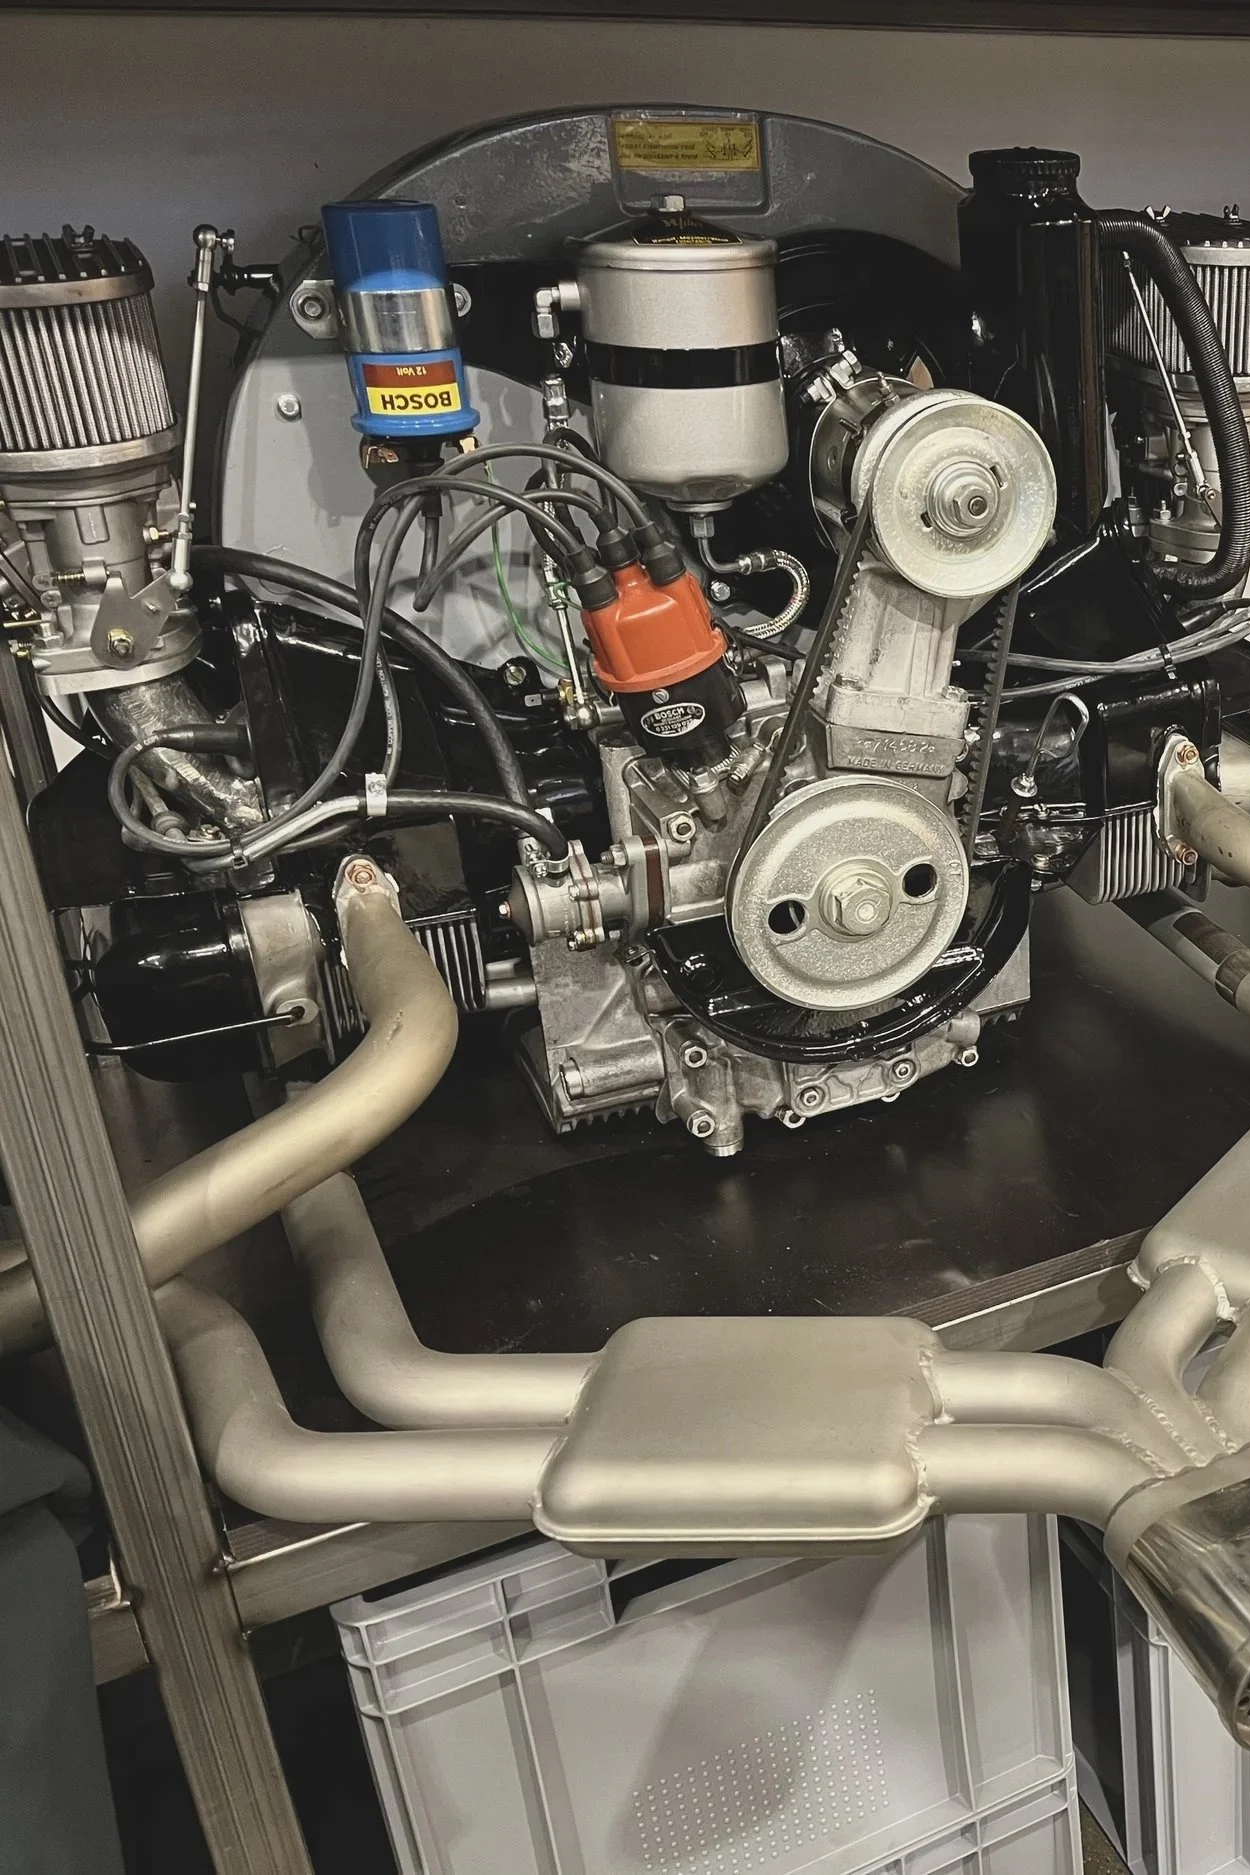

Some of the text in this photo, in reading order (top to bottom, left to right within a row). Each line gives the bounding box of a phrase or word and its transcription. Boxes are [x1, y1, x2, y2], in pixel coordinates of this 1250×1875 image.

[396, 366, 427, 376] 12 Volt
[380, 391, 452, 411] BOSCH
[654, 707, 685, 721] BOSCH
[847, 755, 877, 769] MADE
[895, 760, 946, 774] GERMANY
